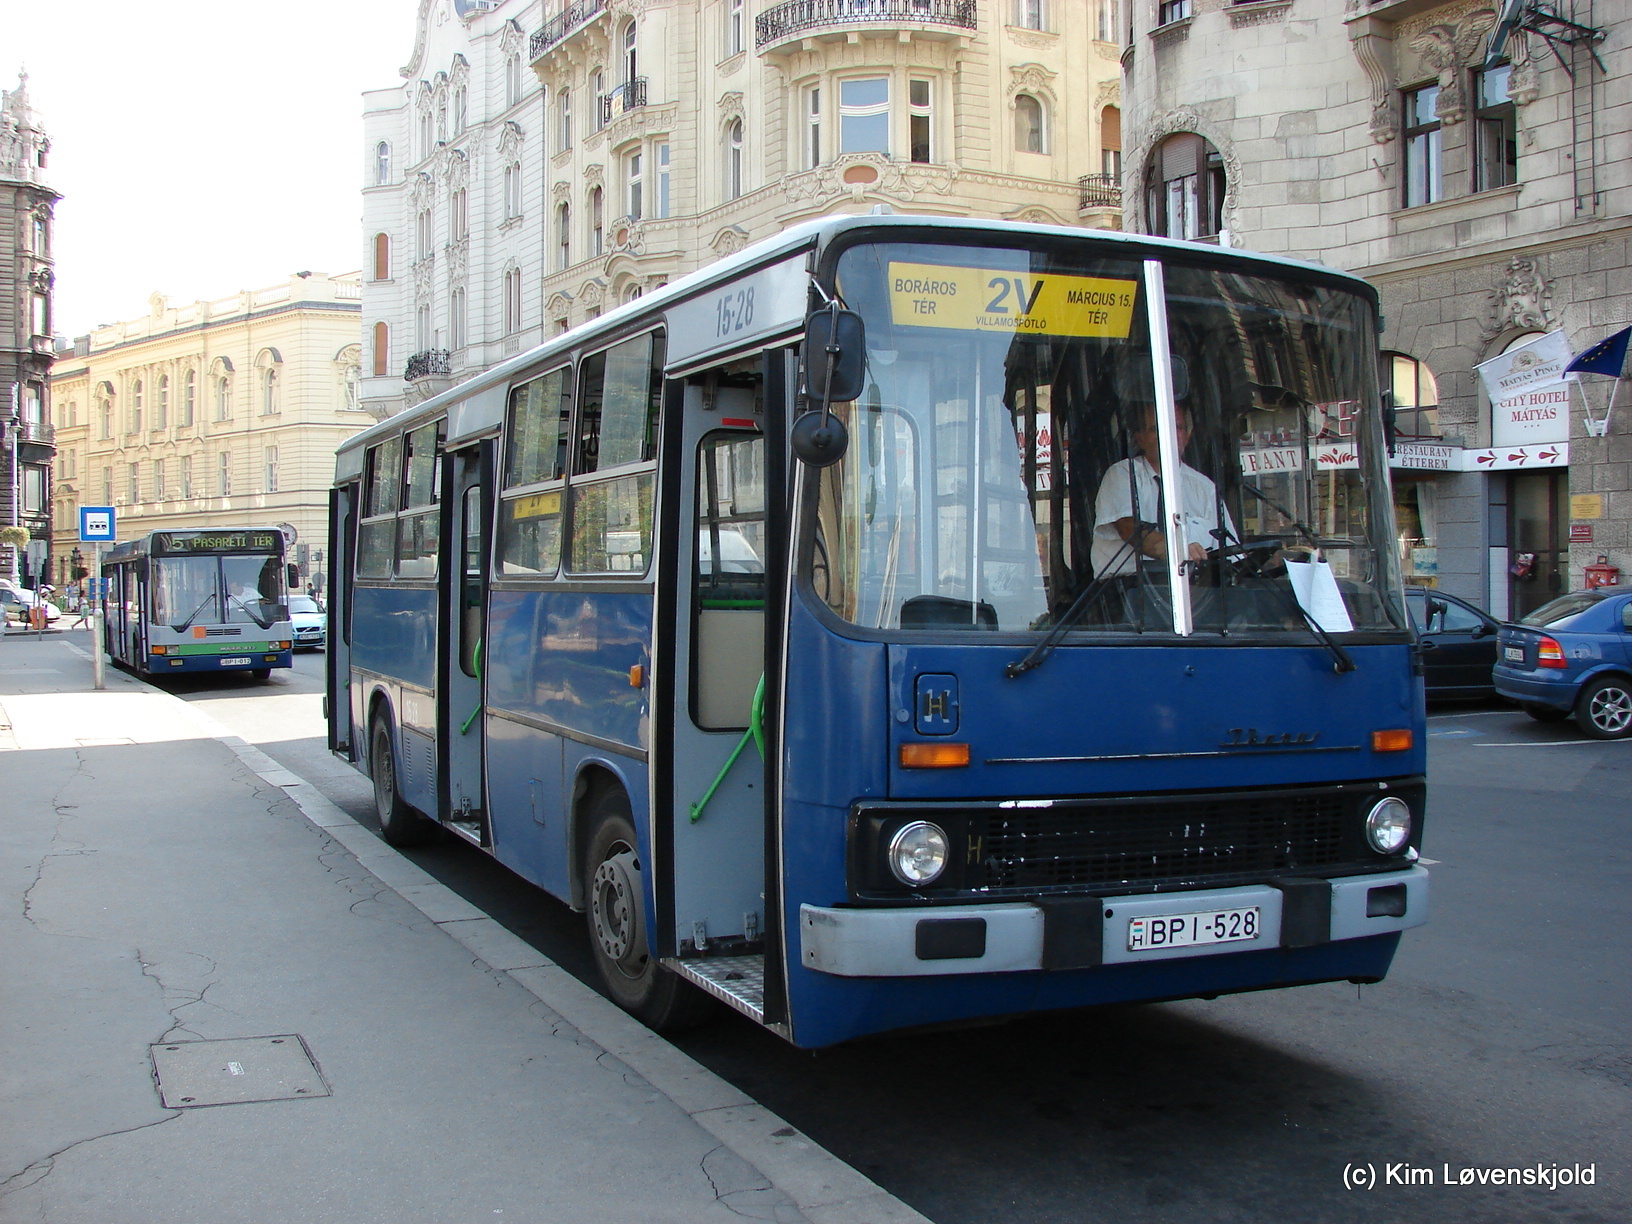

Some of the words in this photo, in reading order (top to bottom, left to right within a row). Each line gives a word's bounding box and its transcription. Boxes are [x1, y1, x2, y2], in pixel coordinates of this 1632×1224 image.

[895, 277, 957, 296] BORÁROS
[984, 277, 1045, 315] 2V
[1067, 288, 1115, 306] MÁRCIUS
[1118, 294, 1132, 308] 15.
[913, 297, 937, 315] TÉR
[975, 315, 1047, 329] VILLAMOSPÓTLÓ
[1088, 309, 1109, 325] TÉR
[1529, 391, 1569, 405] HOTEL
[1511, 405, 1557, 422] MÁTYÁS
[1396, 444, 1453, 458] RESTAURANT
[1401, 455, 1449, 469] ÉTTEREM
[193, 534, 247, 548] PASARÉTI
[253, 534, 273, 547] TÉR
[1151, 911, 1255, 945] BPI-528
